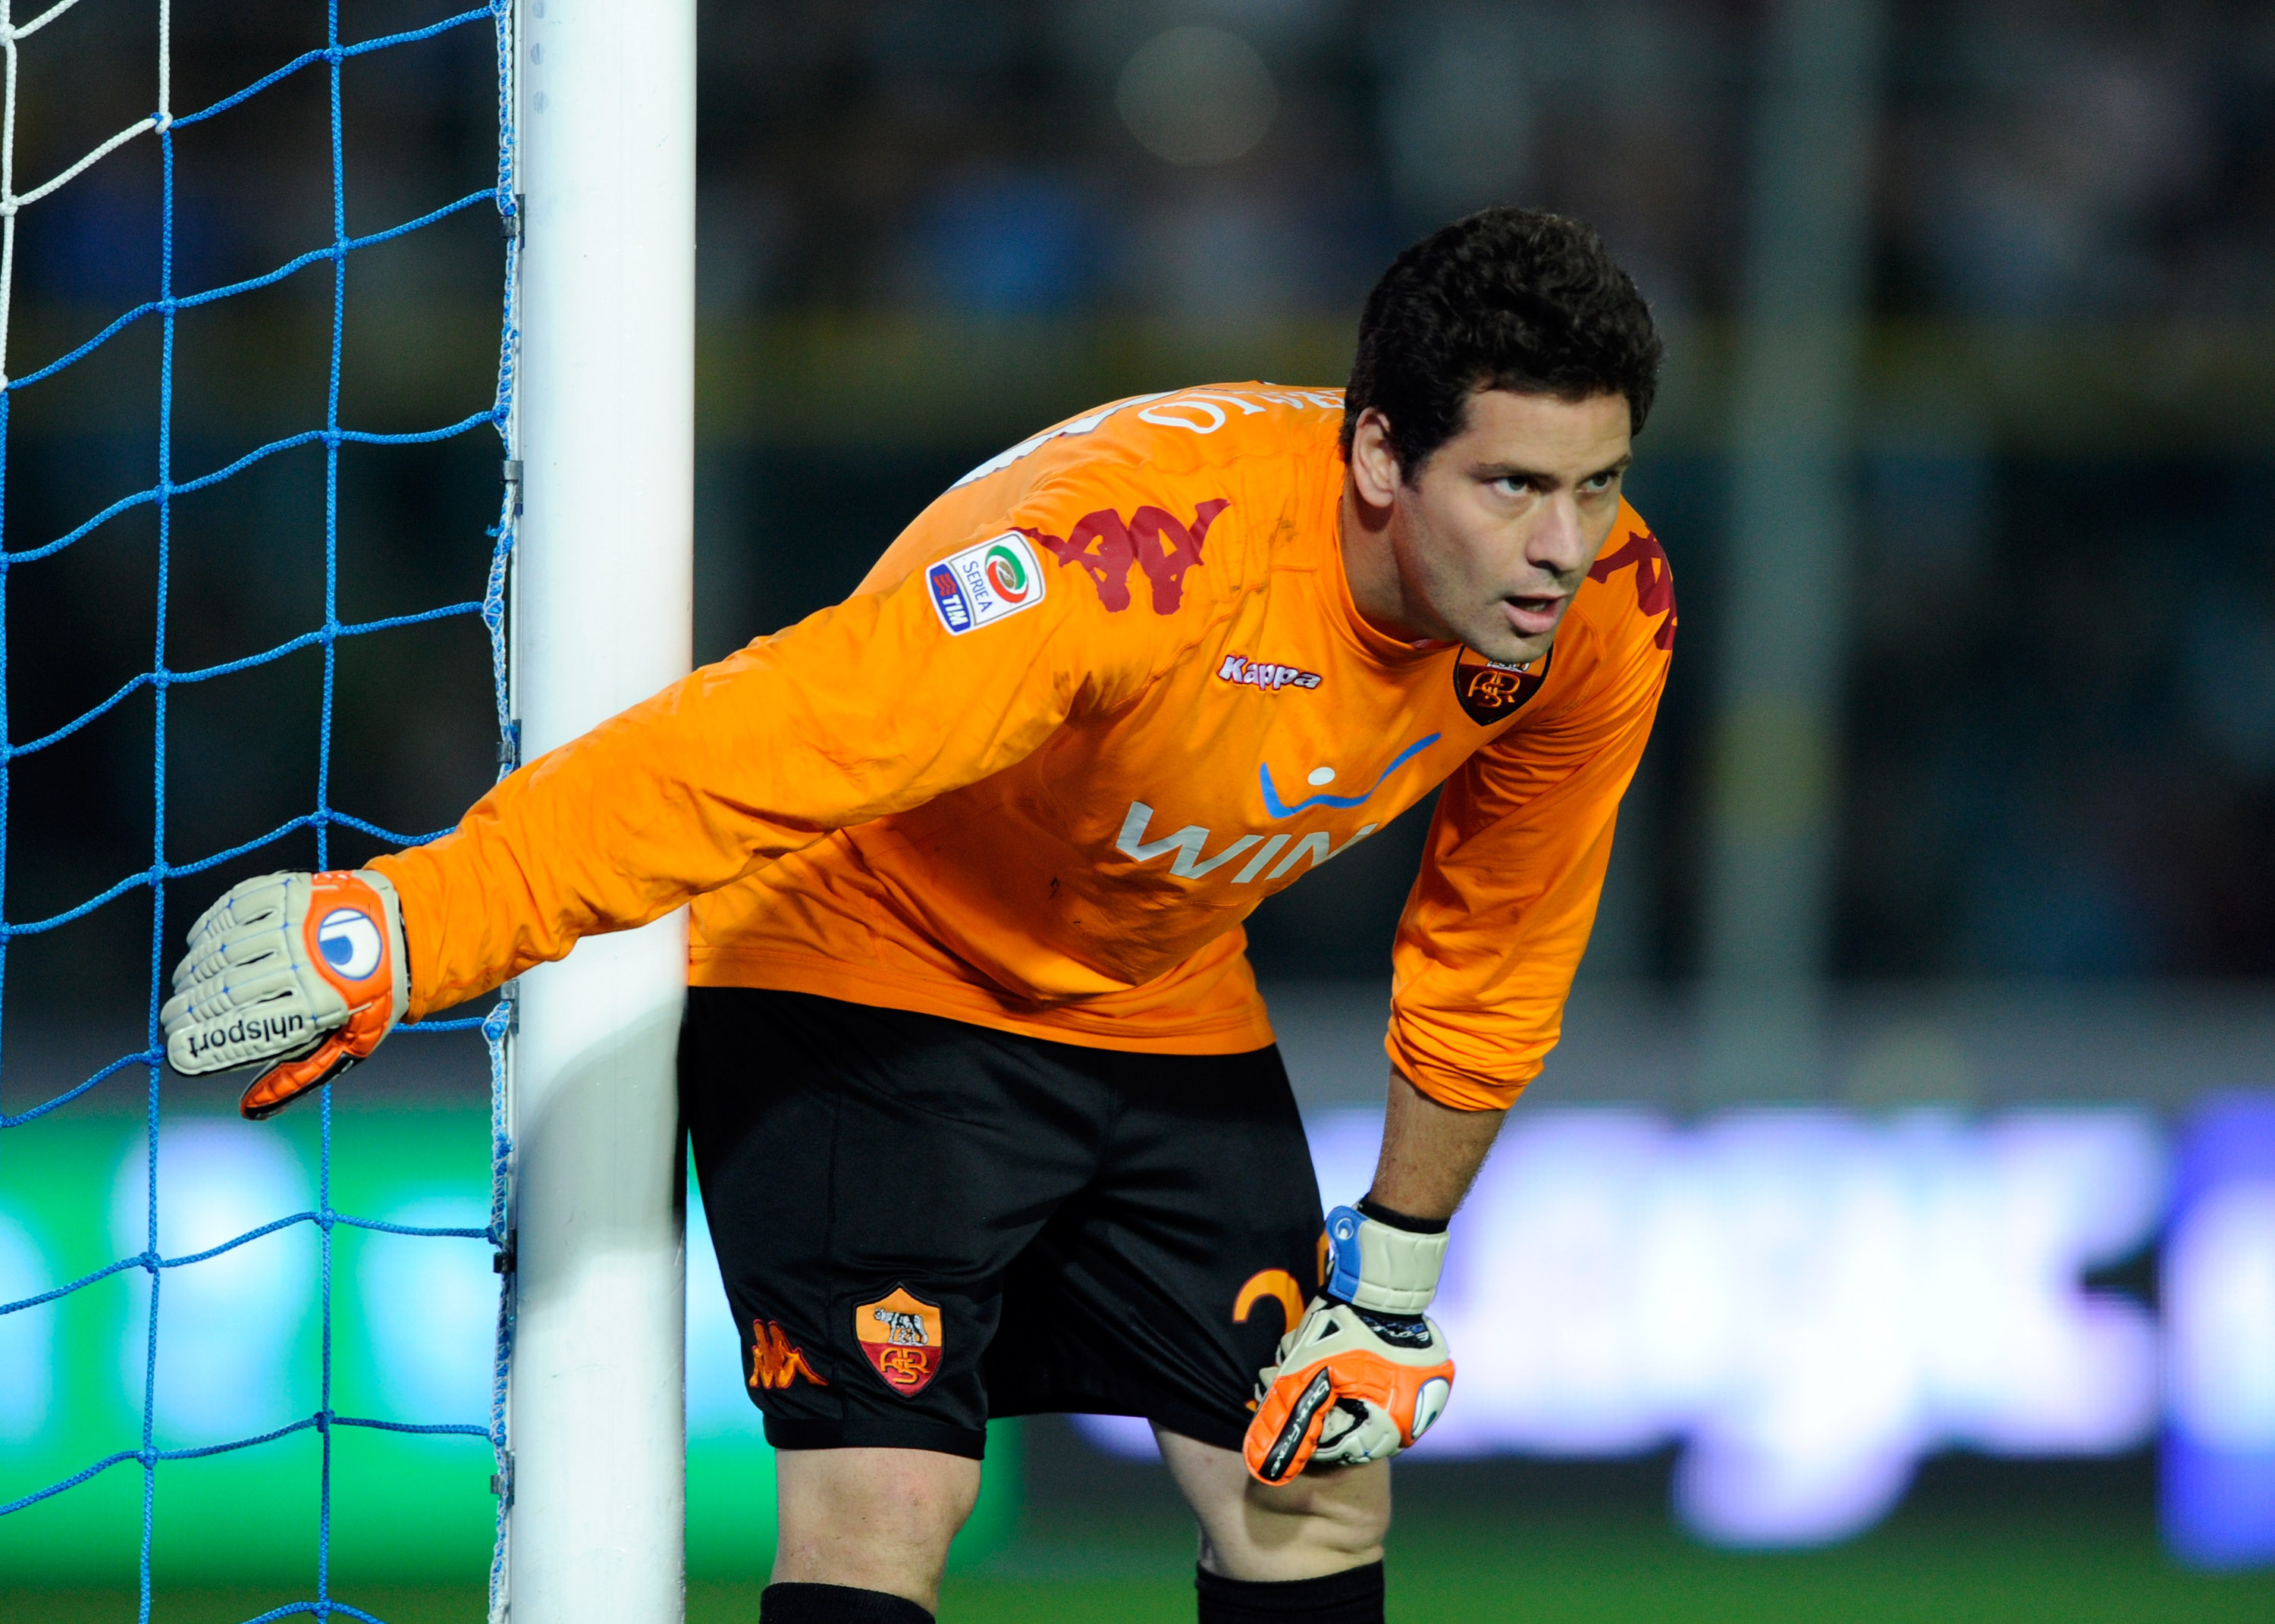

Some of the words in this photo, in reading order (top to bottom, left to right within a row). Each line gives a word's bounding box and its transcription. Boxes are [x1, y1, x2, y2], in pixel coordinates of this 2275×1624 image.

[963, 561, 989, 601] SERIE
[978, 601, 993, 613] A
[943, 594, 968, 626] TIM
[1217, 654, 1323, 691] Kappa
[188, 1014, 303, 1058] uhlsport
